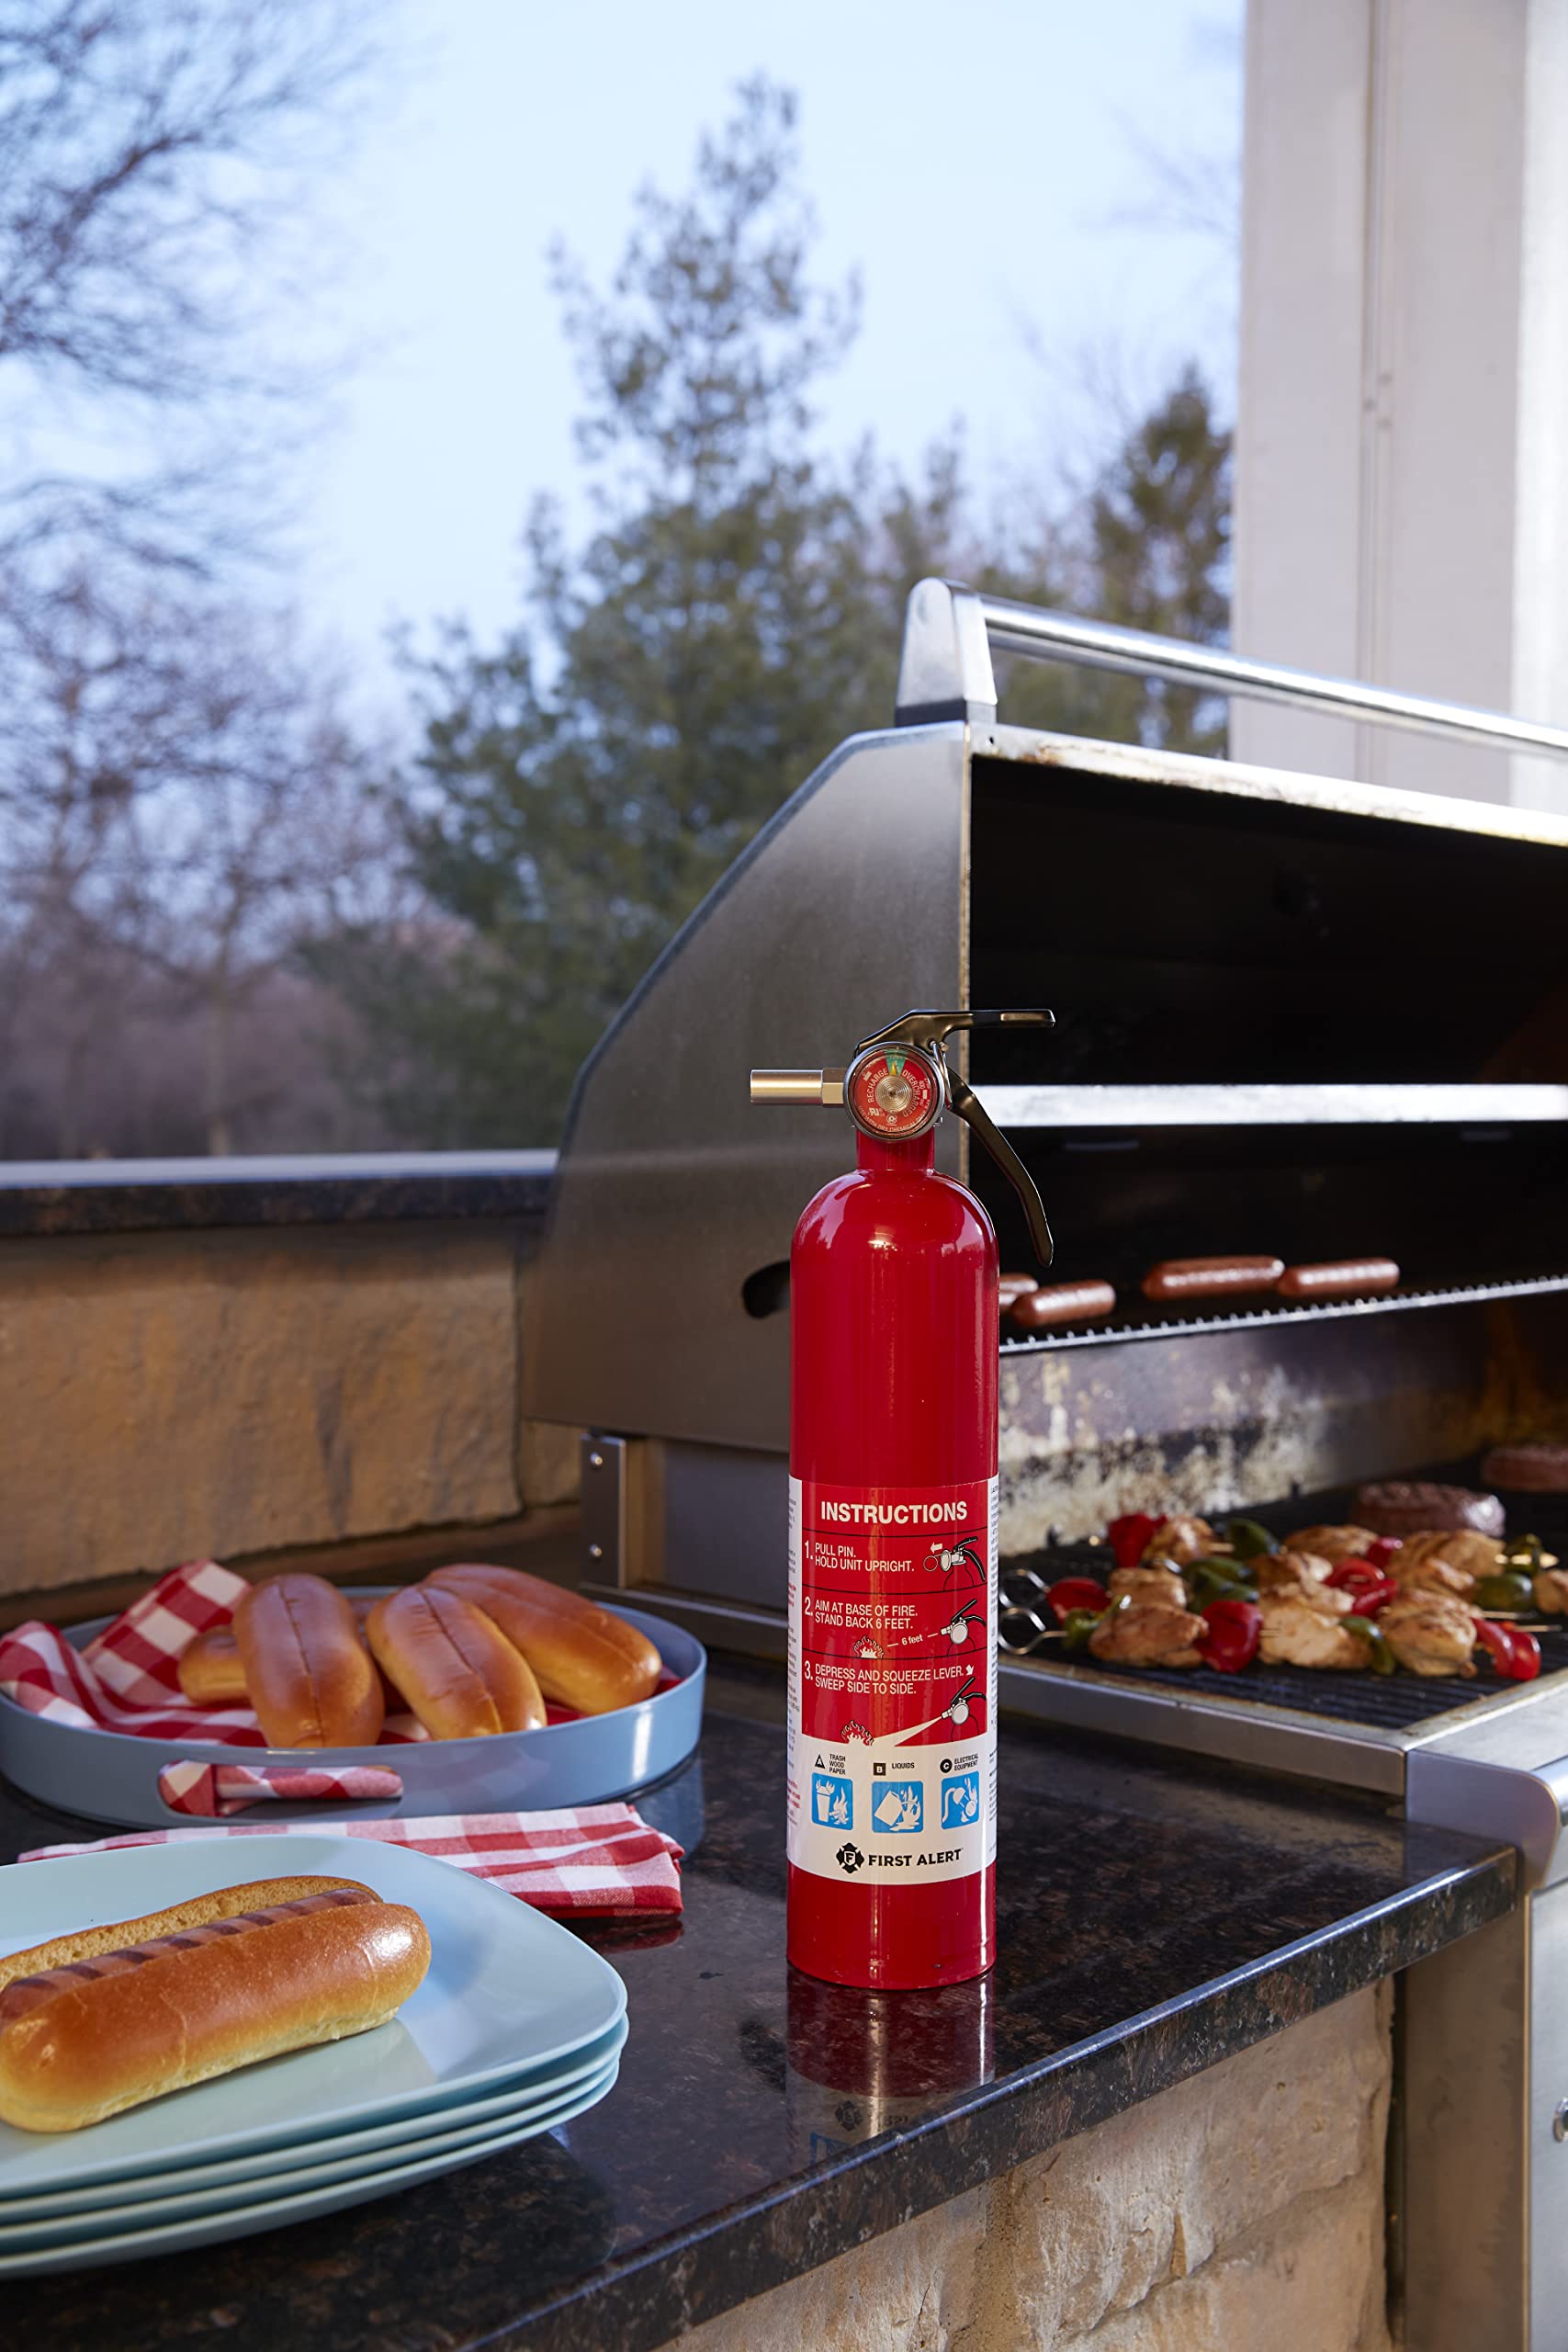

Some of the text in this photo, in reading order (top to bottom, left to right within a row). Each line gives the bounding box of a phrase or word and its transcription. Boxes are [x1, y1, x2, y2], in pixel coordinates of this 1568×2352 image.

[867, 1068, 889, 1103] RECHARGE
[902, 1069, 920, 1117] OVERCHARGED
[865, 1115, 877, 1128] WITH
[877, 1123, 887, 1131] DRY
[888, 1122, 917, 1132] CHEMICAL
[821, 1501, 967, 1524] INSTRUCTIONS
[804, 1540, 856, 1560] 1. PULL PIN.
[815, 1556, 914, 1572] HOLD UNIT UPRIGHT.
[804, 1597, 918, 1616] 2. AIM AT BASE OF FIRE.
[815, 1612, 913, 1629] STAND BACK 6 FEET.
[901, 1634, 923, 1645] 6 feet
[804, 1660, 964, 1681] 3. DEPRESS AND SQUEEZE LEVER.
[815, 1677, 917, 1694] SWEEP SIDE TO SIDE.
[829, 1754, 846, 1762] TRASH
[954, 1754, 978, 1764] ELECTRICAL
[954, 1760, 978, 1771] EQUIPMENT
[868, 1849, 961, 1867] FIRST ALERT
